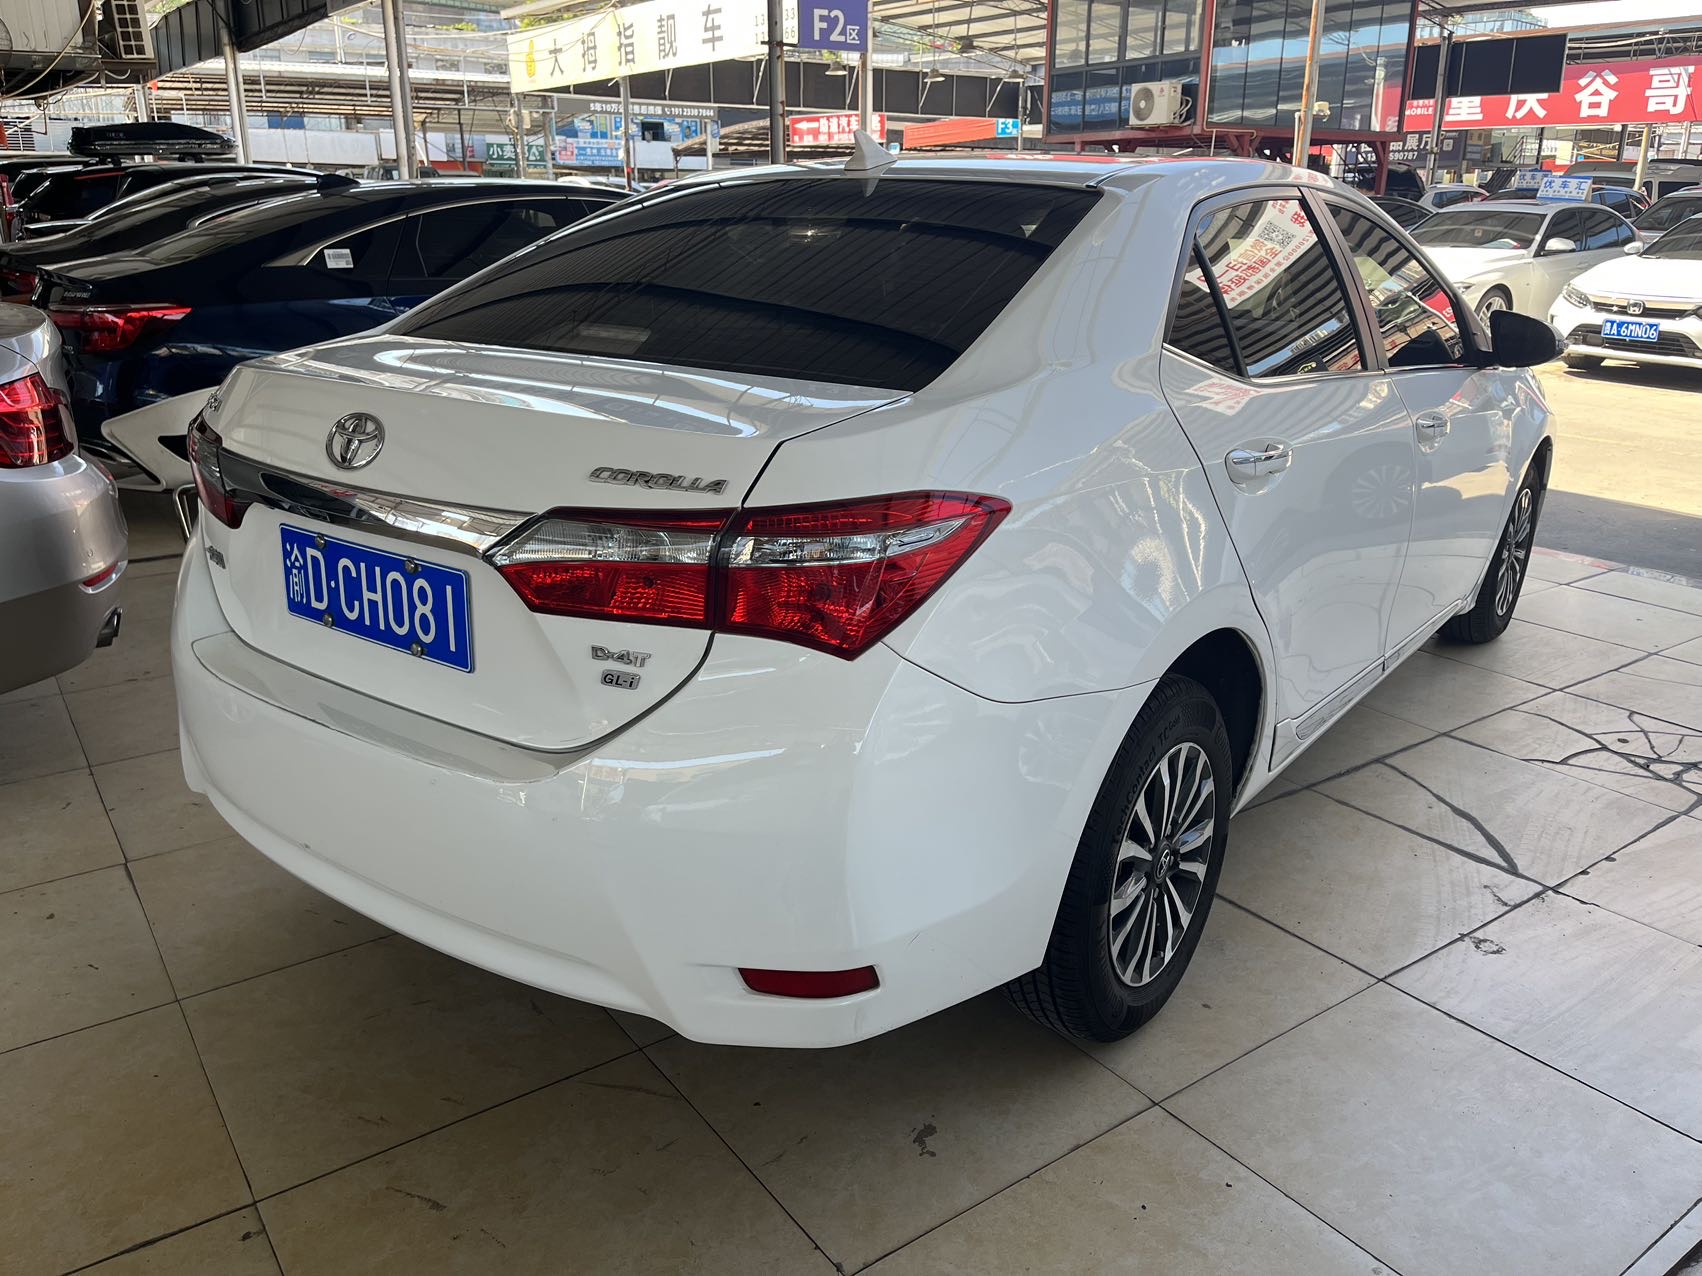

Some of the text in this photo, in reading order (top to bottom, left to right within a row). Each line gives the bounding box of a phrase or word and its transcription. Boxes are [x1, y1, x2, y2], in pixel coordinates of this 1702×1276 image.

[549, 4, 723, 77] 大拇指靓车
[813, 8, 861, 44] F2区
[1544, 179, 1588, 191] 优车汇
[589, 466, 729, 496] COROLLA
[591, 644, 652, 668] D-4T
